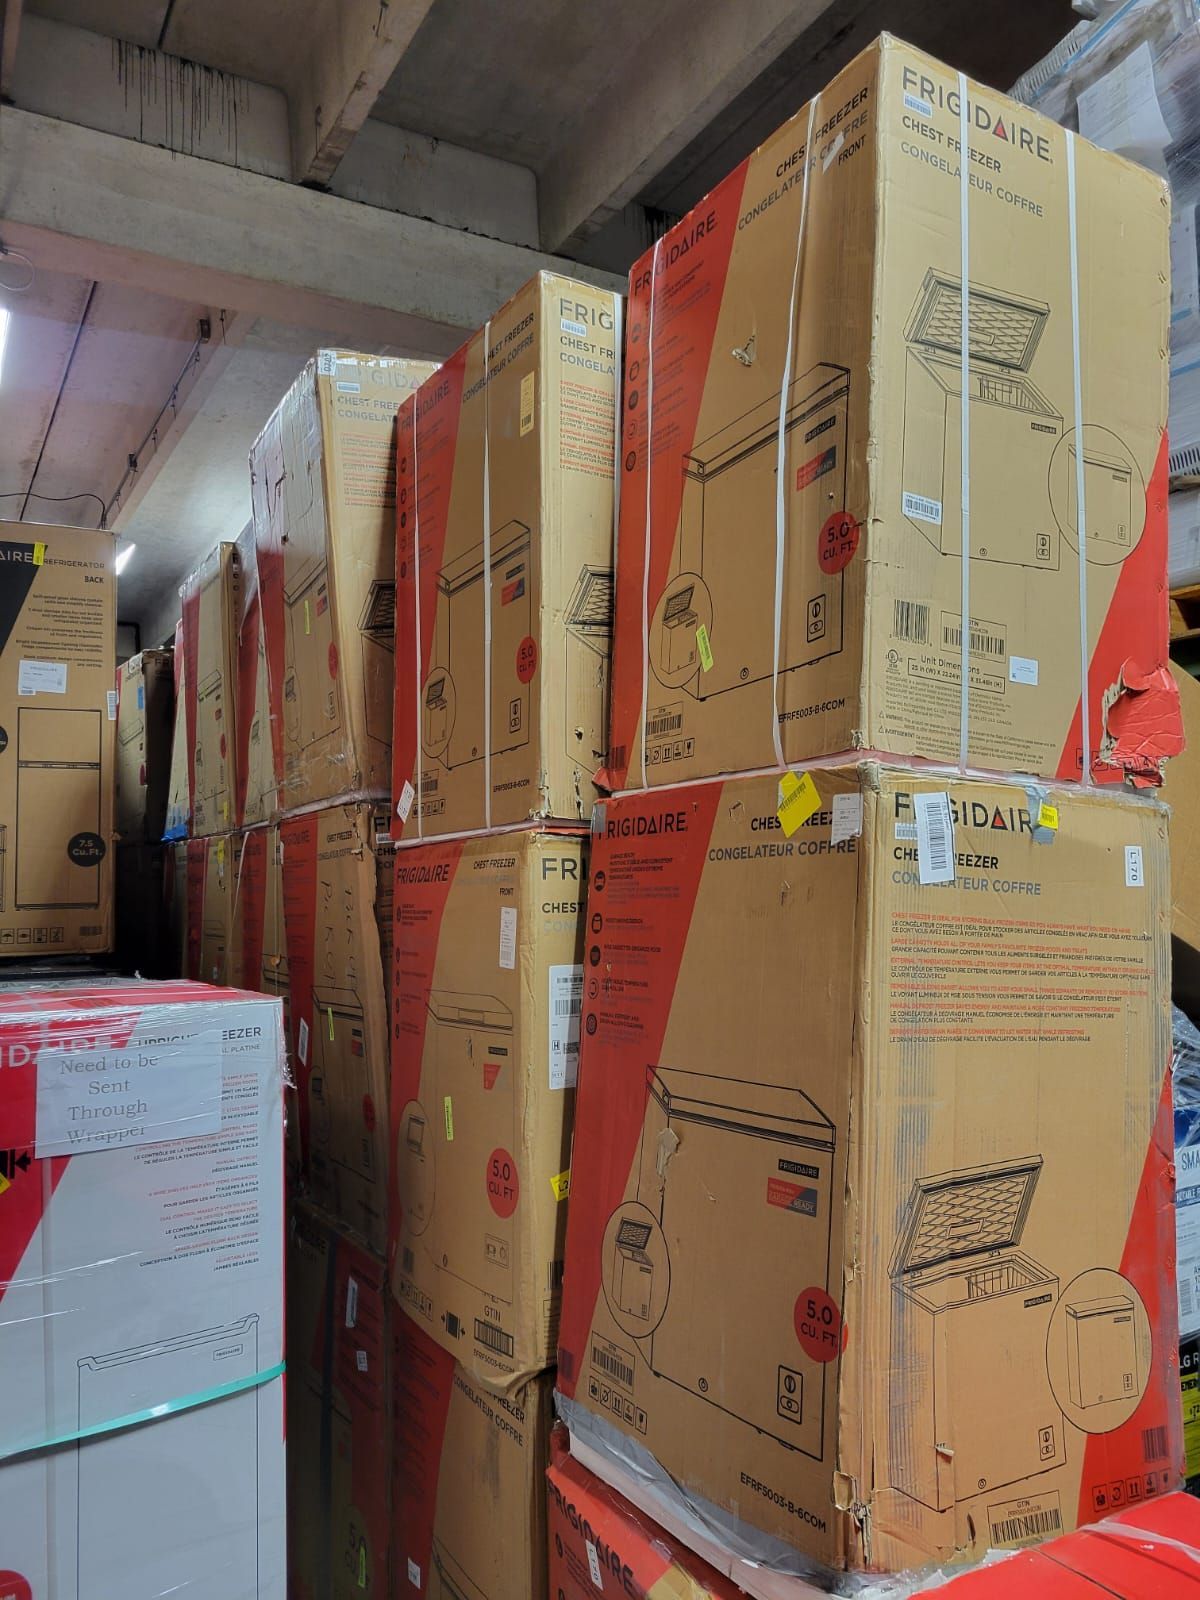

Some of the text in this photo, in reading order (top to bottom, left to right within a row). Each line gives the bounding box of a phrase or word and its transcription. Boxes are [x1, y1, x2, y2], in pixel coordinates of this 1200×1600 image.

[902, 66, 1052, 163] FRIGIDAIRE
[776, 87, 868, 178] CHES FREEZER
[820, 110, 868, 160] COFRE
[838, 134, 866, 167] FRONT
[902, 115, 1001, 173] CHEST FREZER
[901, 141, 1043, 217] CONGELAEUR COFFRE
[634, 210, 716, 298] FRGIDAIRE
[505, 312, 534, 345] FREEZER
[508, 332, 534, 364] COFFRE
[560, 335, 596, 352] CHEST
[337, 396, 370, 407] CHEST
[827, 521, 850, 543] 5.0
[823, 545, 838, 561] CU.
[44, 558, 105, 569] REFRIGERATOR
[85, 575, 104, 584] BACK
[921, 655, 980, 675] Unit Dimenons
[751, 816, 782, 831] CHES
[72, 848, 102, 857] Cu.Ft.
[79, 839, 93, 847] 7.5
[709, 843, 793, 861] CONGELATEUR
[397, 863, 450, 884] FRIGIDAIRE
[473, 858, 515, 869] CHEST FREEZER
[1130, 851, 1138, 881] L170
[500, 887, 514, 896] FRONT
[993, 879, 1041, 896] COFFRE
[541, 902, 584, 914] CHEST
[231, 1043, 260, 1053] PLATINE
[61, 1053, 159, 1074] Need to be
[88, 1079, 130, 1096] Sent
[68, 1099, 149, 1121] Through
[67, 1126, 145, 1146] Wrapper
[492, 1159, 511, 1181] 5.0
[780, 1161, 817, 1177] FRIGIDAIRE
[488, 1181, 502, 1197] CU.
[484, 1305, 501, 1322] GTIN
[806, 1300, 832, 1325] 5.0
[800, 1322, 838, 1347] CU. FT.
[495, 1413, 523, 1447] COFFRE
[740, 1471, 826, 1533] EFRF5003-B-6COM
